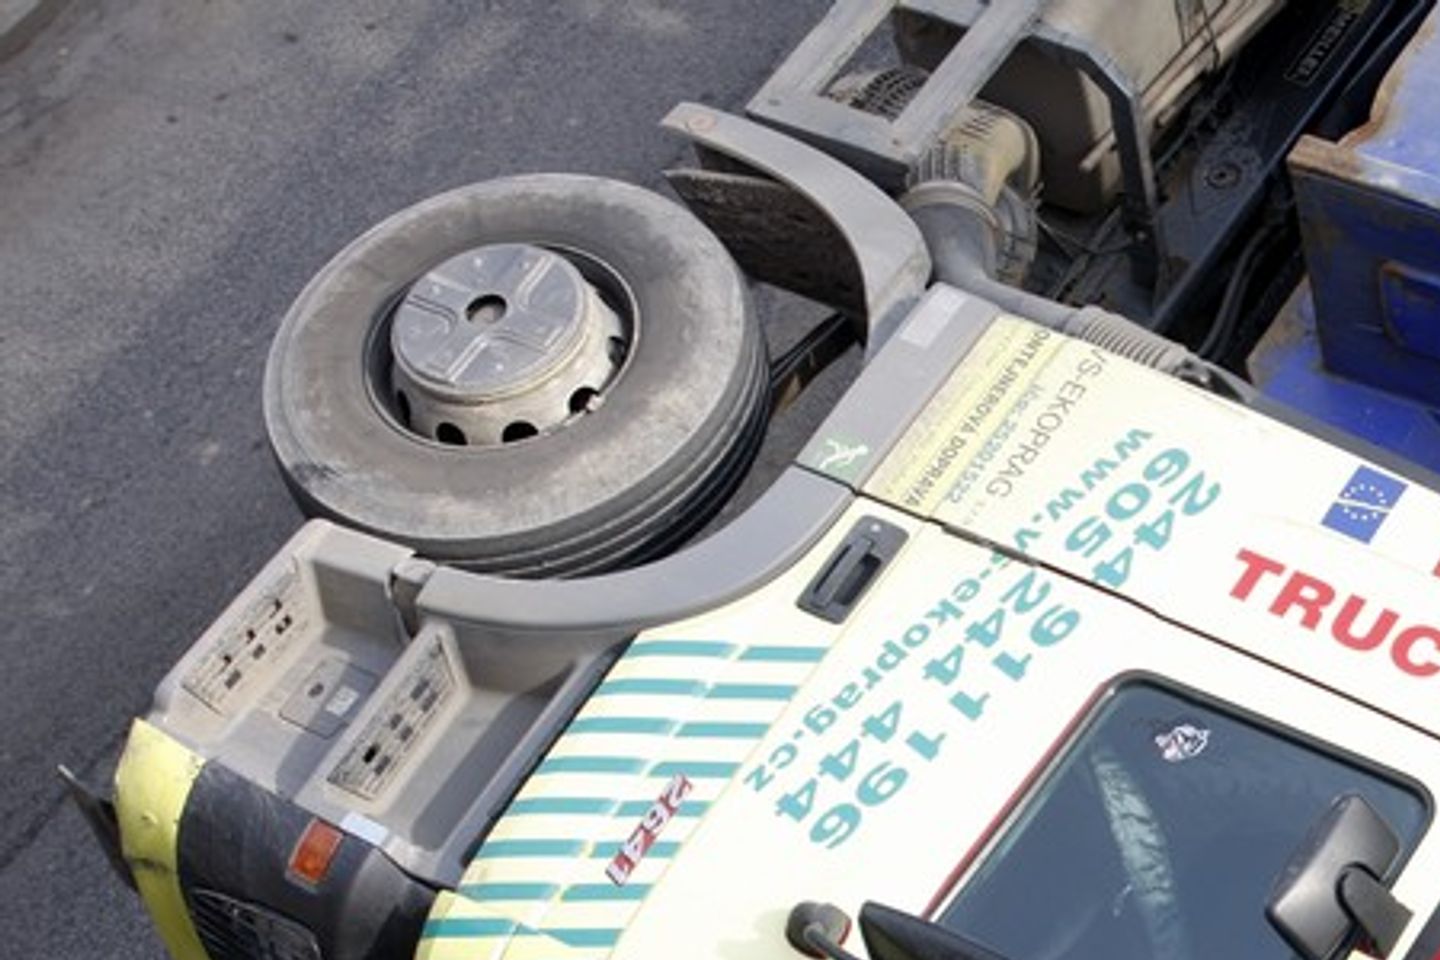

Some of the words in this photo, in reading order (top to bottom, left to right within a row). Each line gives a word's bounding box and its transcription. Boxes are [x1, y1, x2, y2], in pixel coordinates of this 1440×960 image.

[960, 329, 1051, 436] ONTEJNEROVÁ
[1065, 448, 1191, 553] 605
[1091, 471, 1222, 588] 244
[743, 427, 1154, 792] www.vs-ekoprag.cz
[922, 570, 1052, 686] 244
[774, 700, 904, 824] 444
[605, 773, 693, 887] 2641
